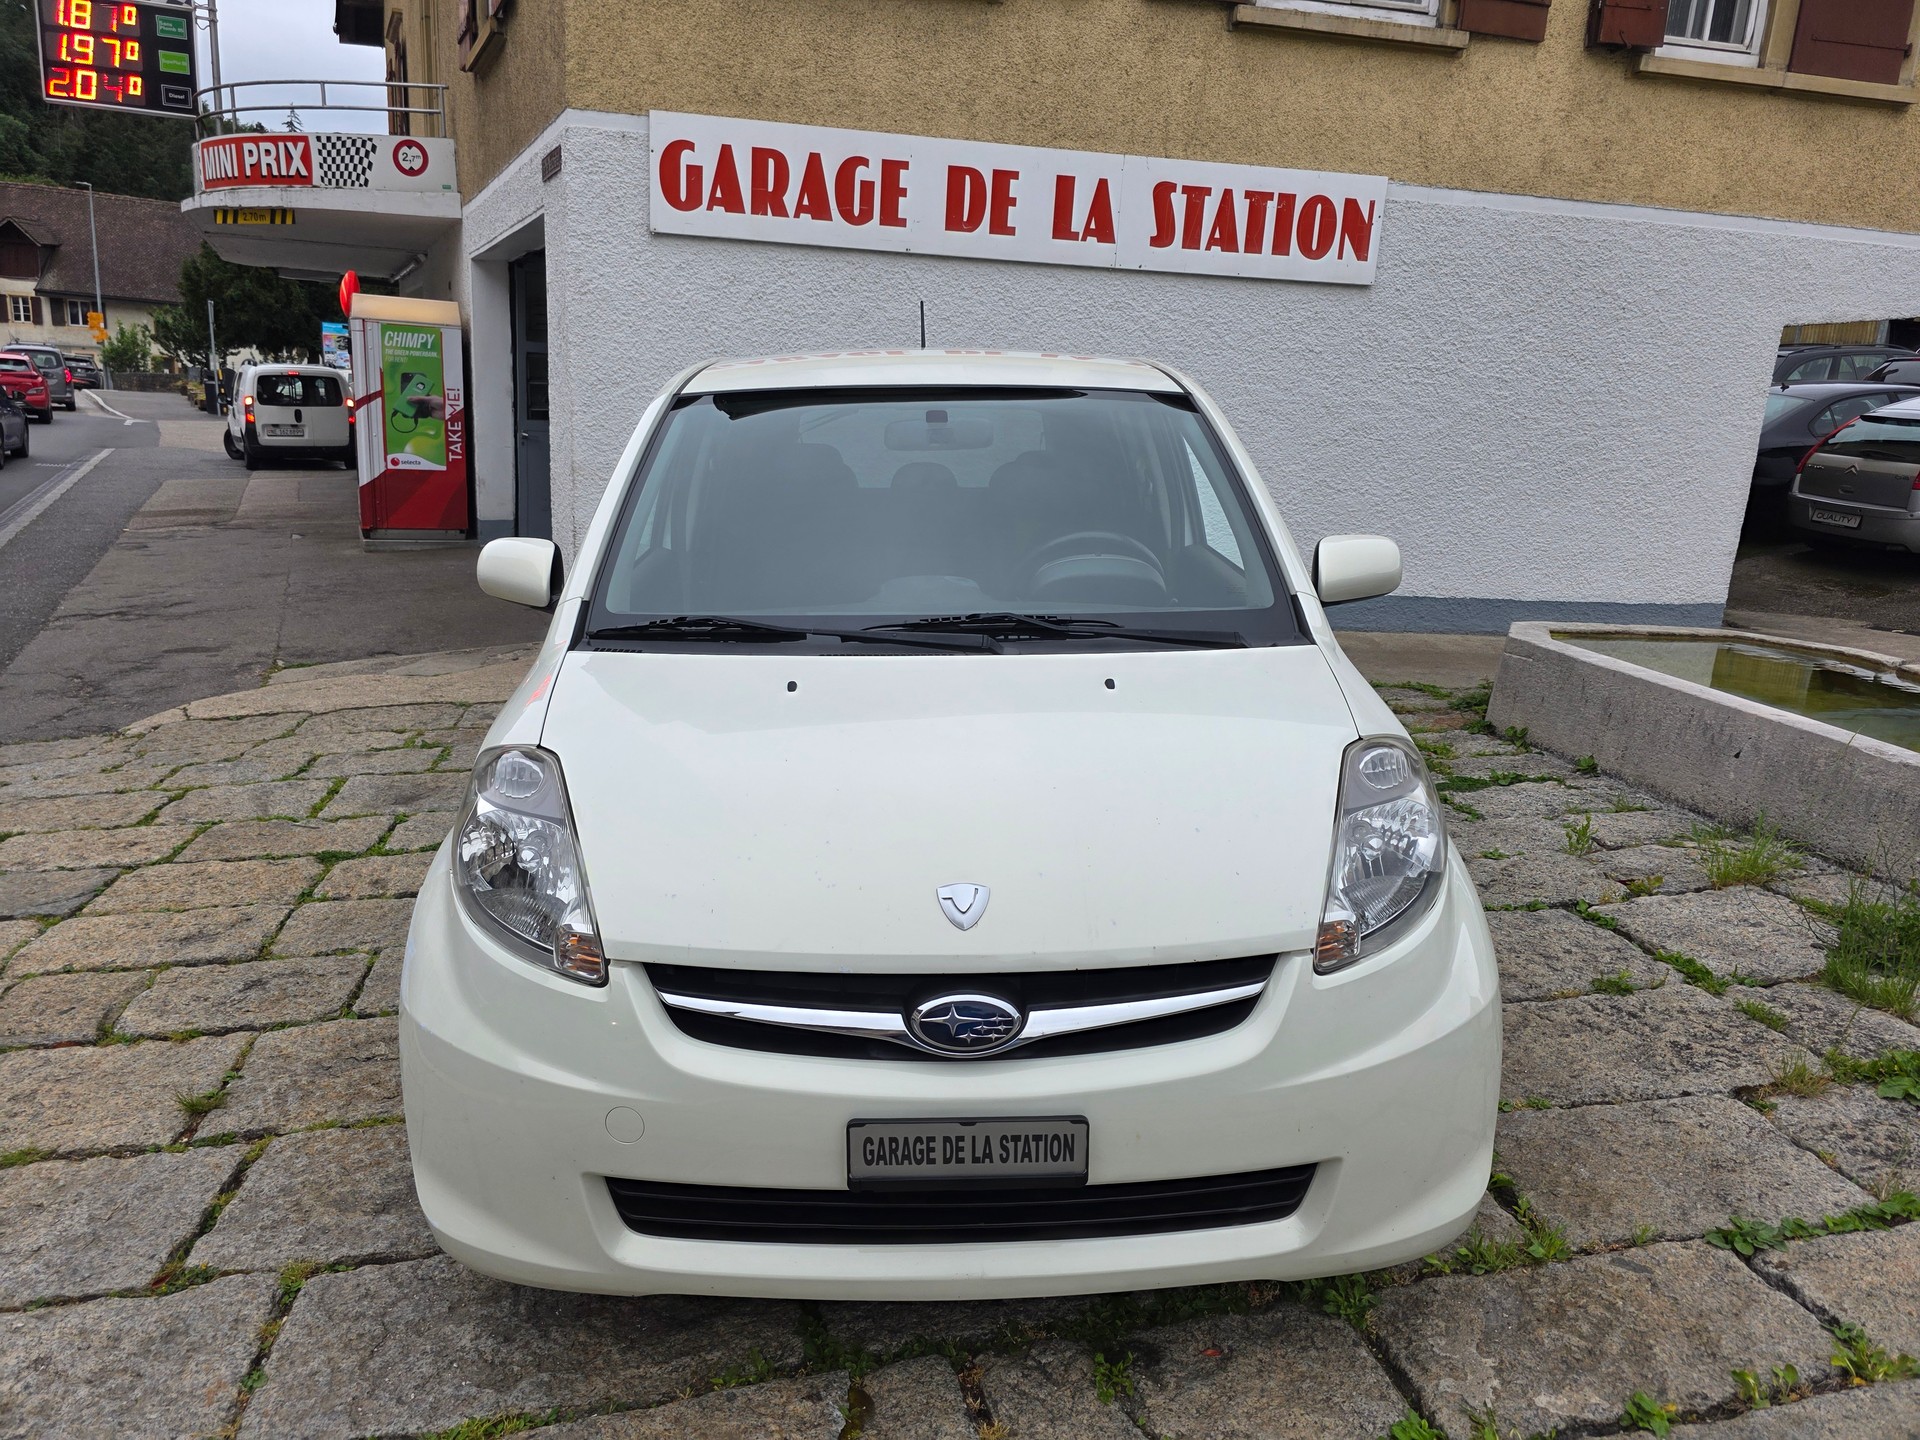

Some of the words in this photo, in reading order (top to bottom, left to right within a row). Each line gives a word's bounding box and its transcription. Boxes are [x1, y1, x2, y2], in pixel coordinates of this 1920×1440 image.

[203, 143, 239, 181] MINI
[242, 141, 309, 178] PRIX
[659, 139, 910, 228] GARAGE
[945, 165, 1020, 236] DE
[1052, 175, 1116, 244] LA
[1149, 180, 1377, 262] STATION
[384, 330, 436, 349] CHIMPY
[446, 387, 461, 418] ME!
[447, 421, 463, 462] TAKE
[1816, 511, 1853, 524] QUALITY
[862, 1135, 937, 1167] GARAGE
[942, 1135, 966, 1165] DE
[971, 1134, 995, 1165] LA
[999, 1133, 1075, 1164] STATION
